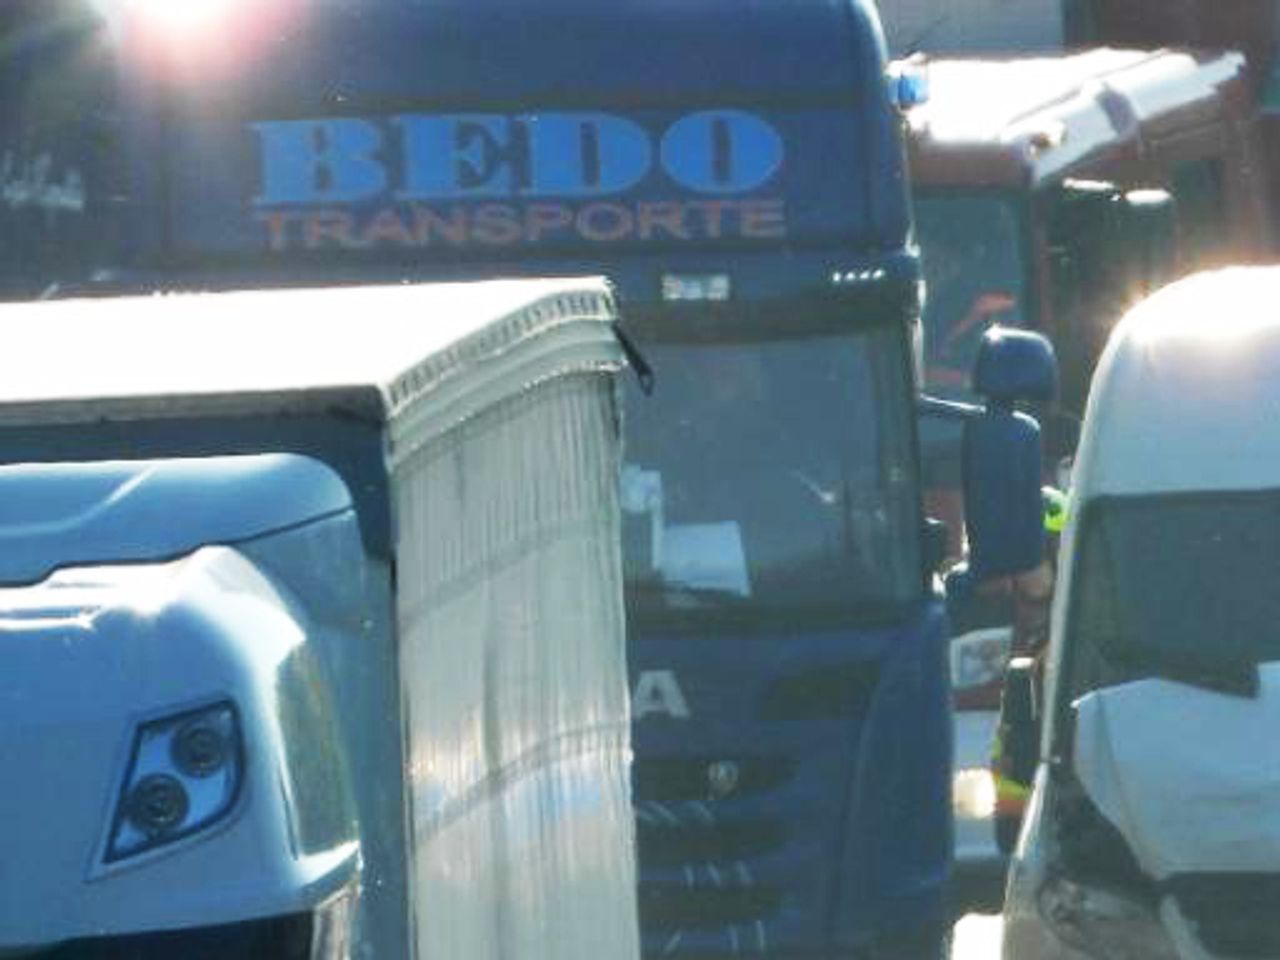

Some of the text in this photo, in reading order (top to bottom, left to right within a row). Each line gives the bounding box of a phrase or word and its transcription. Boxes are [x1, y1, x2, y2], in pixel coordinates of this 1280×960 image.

[247, 109, 785, 206] BEDO
[256, 201, 787, 250] TRANSPORTE
[632, 669, 691, 718] A
